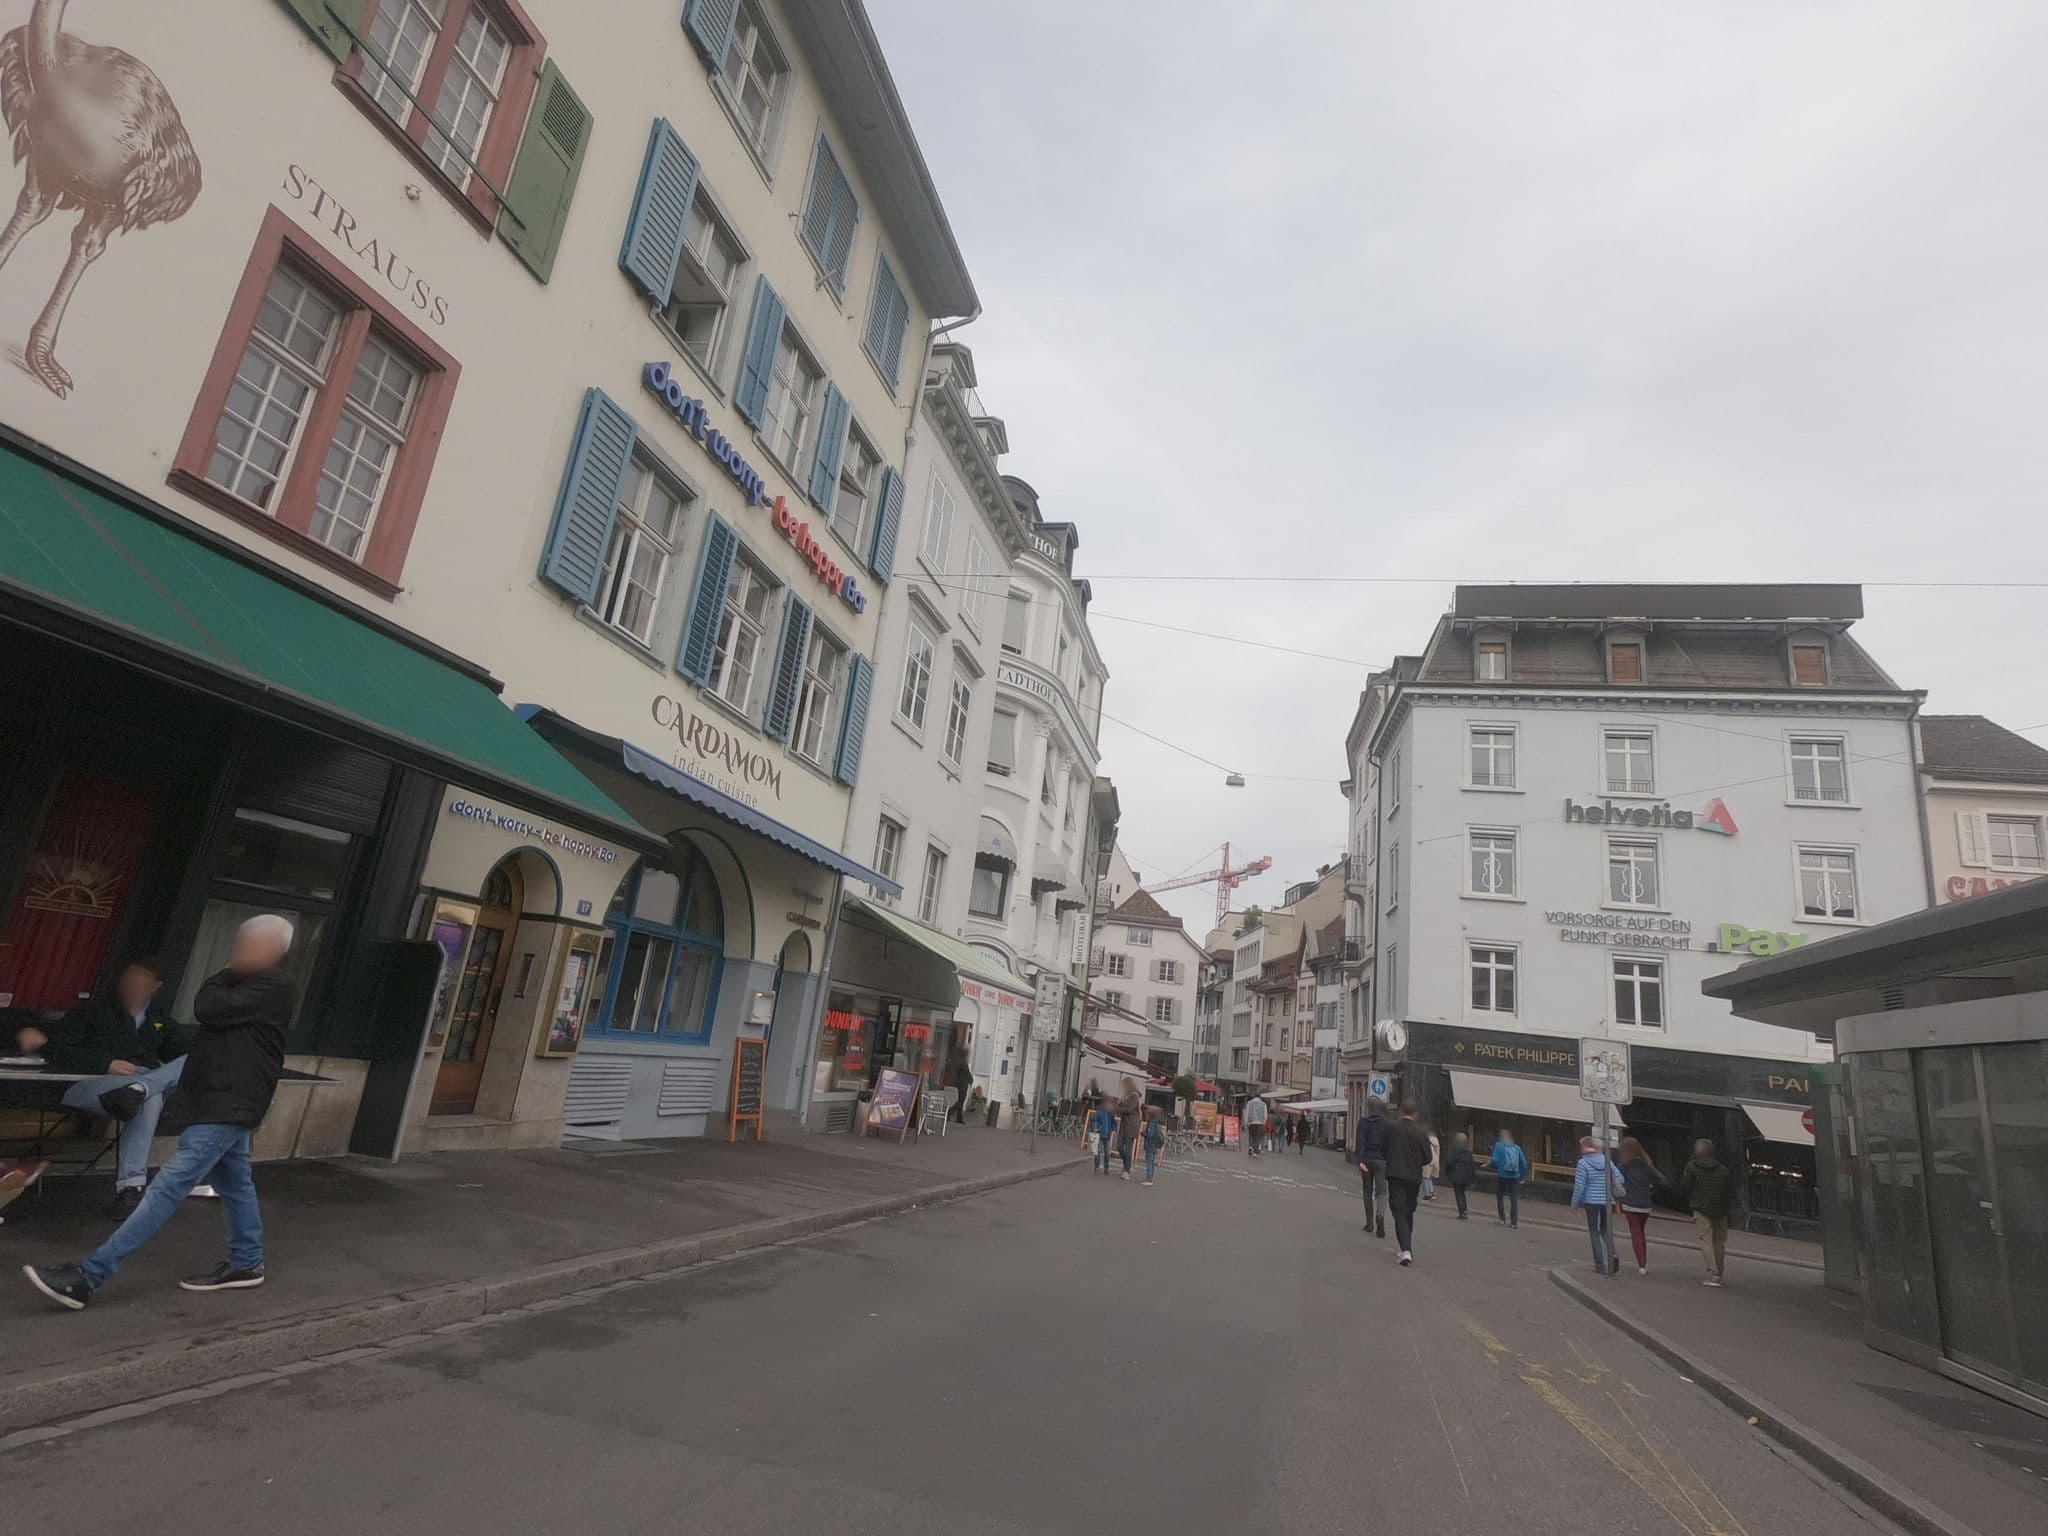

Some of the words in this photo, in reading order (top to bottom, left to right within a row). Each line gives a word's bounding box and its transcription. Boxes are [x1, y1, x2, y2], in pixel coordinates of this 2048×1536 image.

[282, 164, 449, 326] STRAUSS
[643, 361, 710, 441] don't
[706, 428, 765, 507] worry
[772, 495, 800, 540] be
[796, 522, 845, 597] happy
[840, 575, 868, 616] Bar
[651, 695, 782, 802] CARDAMOM
[672, 749, 714, 785] indian
[718, 777, 758, 808] cuisine
[1565, 799, 1694, 829] helvetia
[452, 800, 492, 822] don't
[495, 814, 533, 837] worry
[542, 828, 561, 845] be
[561, 835, 597, 858] happy
[599, 846, 618, 863] Bar
[1946, 876, 2020, 901] CA
[580, 902, 590, 914] 17
[1545, 910, 1622, 929] VORSORGE
[1626, 916, 1656, 930] AUF
[1659, 918, 1692, 934] DEN
[1561, 928, 1610, 945] PUNKT
[1612, 931, 1693, 951] GEBRACHT
[1474, 1042, 1515, 1061] PATEK
[1517, 1048, 1576, 1067] PHILIPPE
